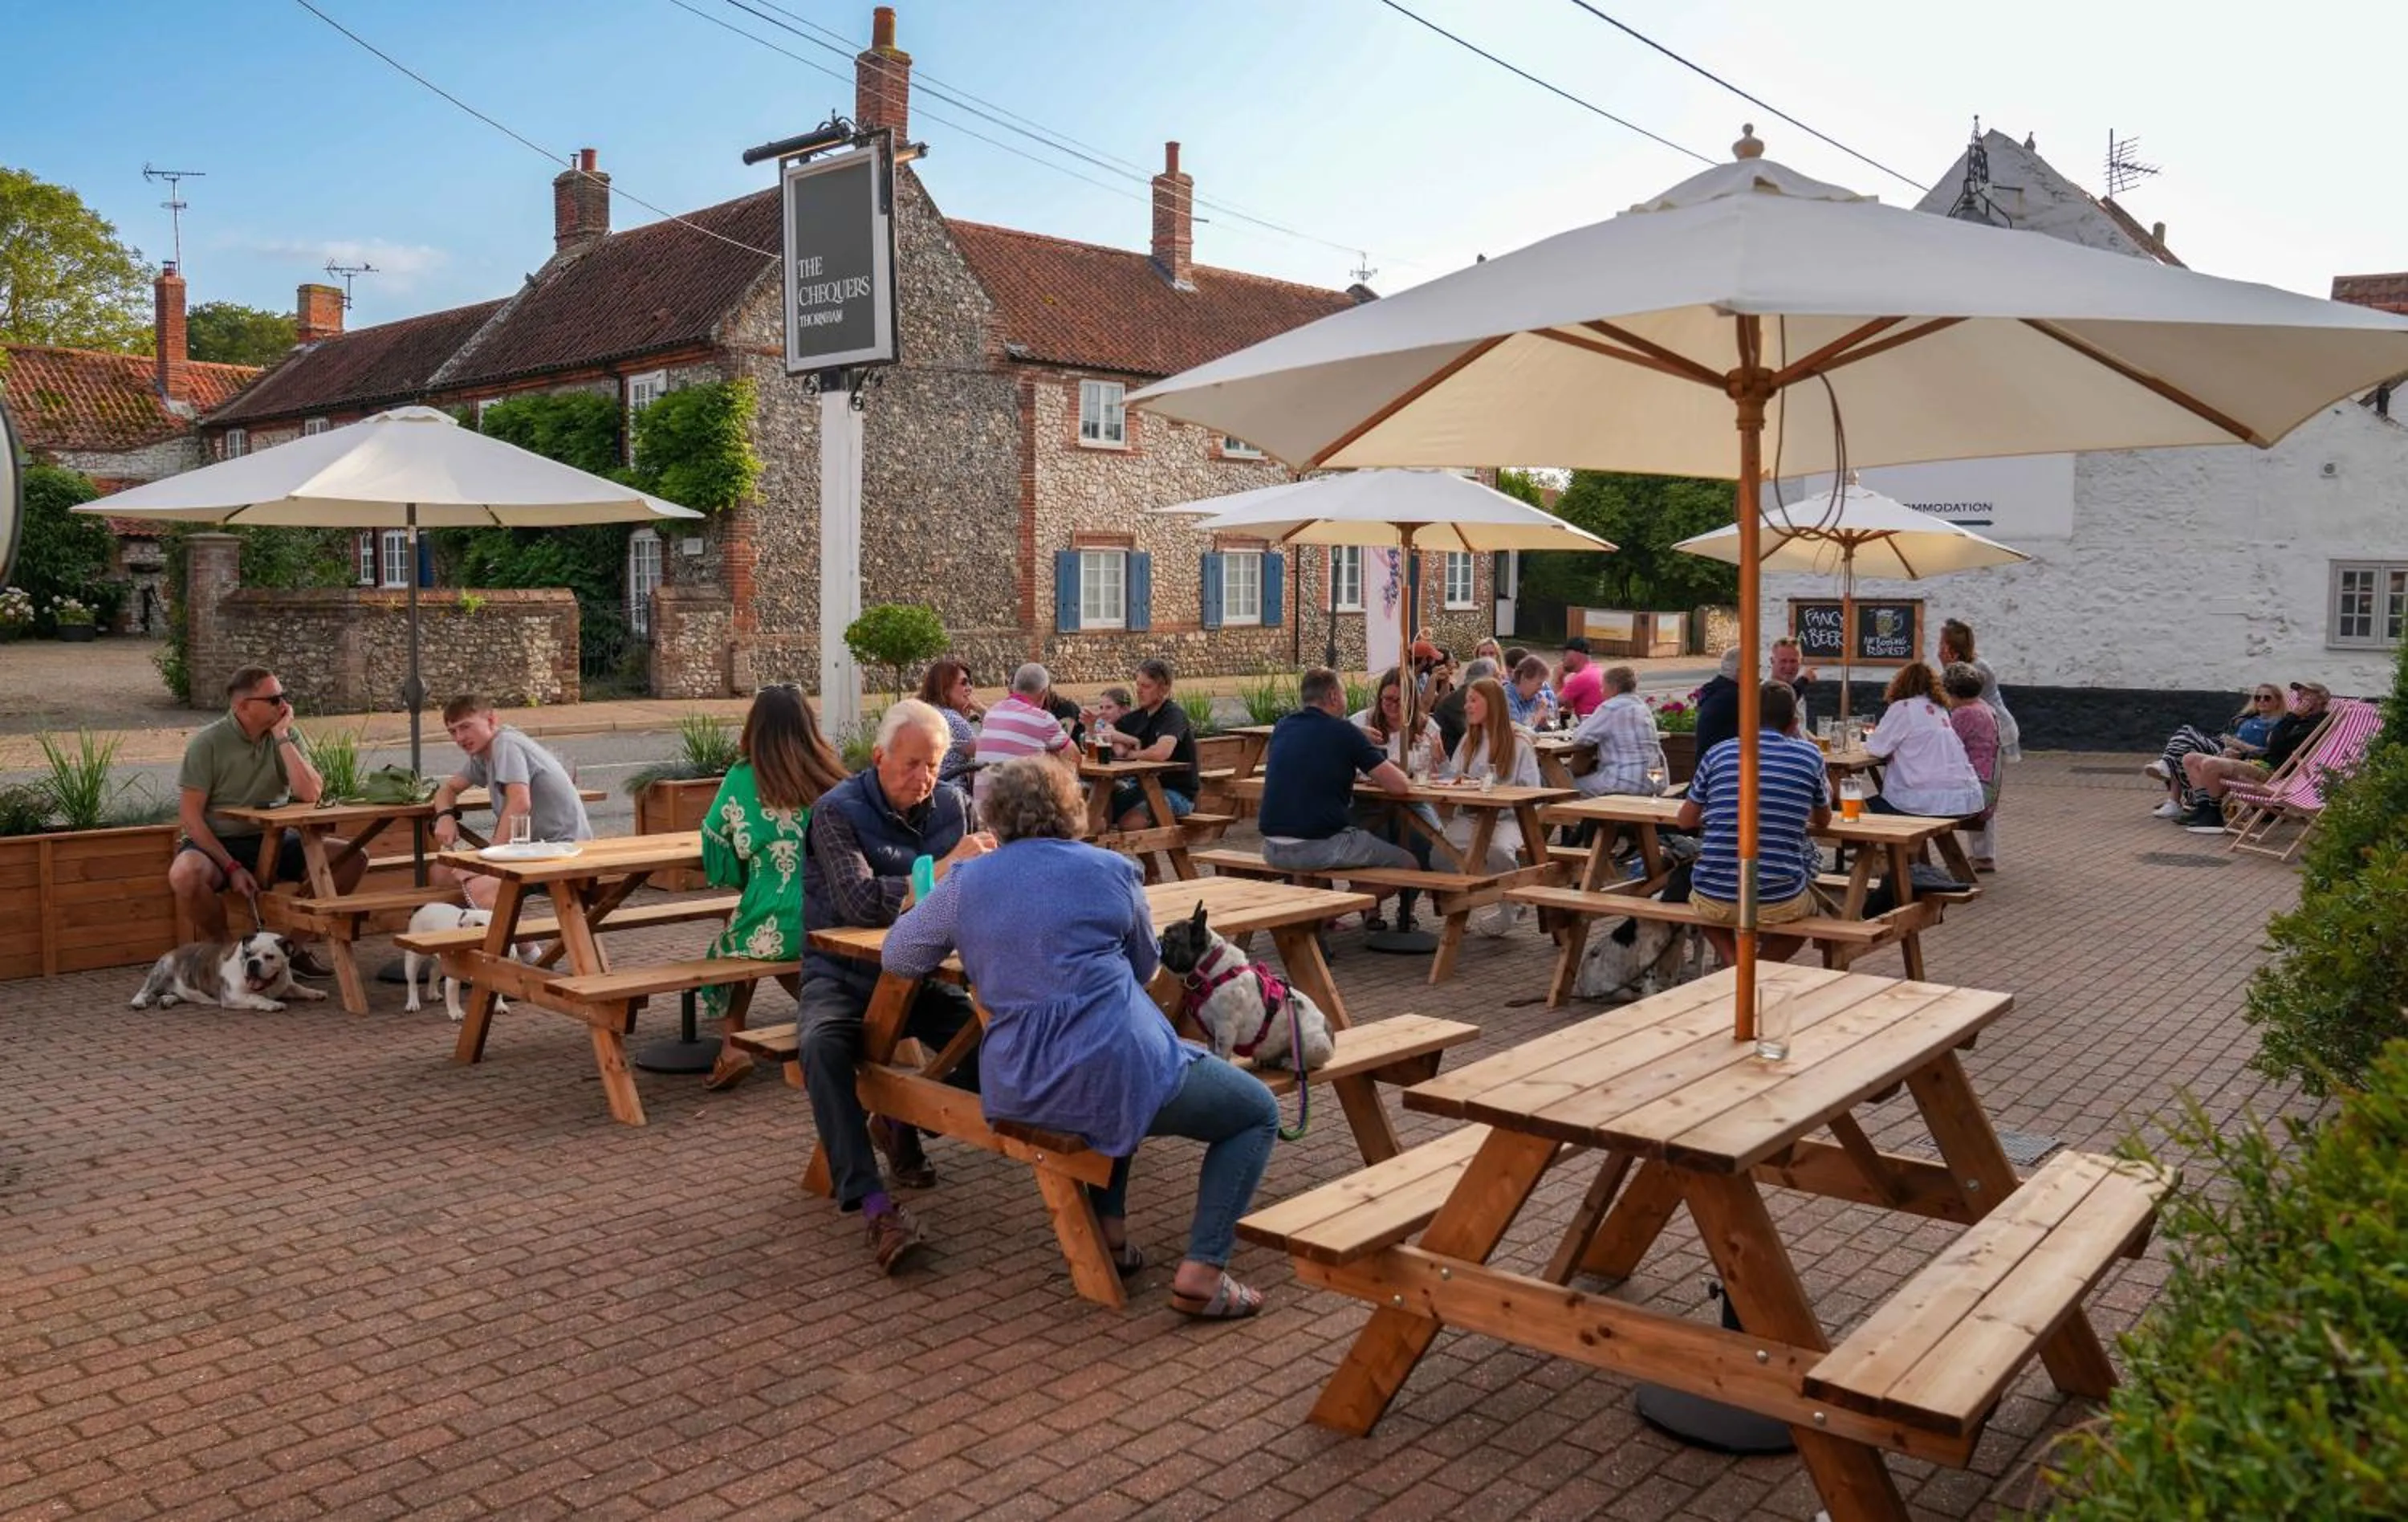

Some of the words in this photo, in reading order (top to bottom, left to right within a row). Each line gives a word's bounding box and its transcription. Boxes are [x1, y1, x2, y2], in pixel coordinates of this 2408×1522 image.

[798, 256, 822, 279] THE
[799, 275, 871, 306] CHEQUERS
[1805, 608, 1843, 629] FANCY
